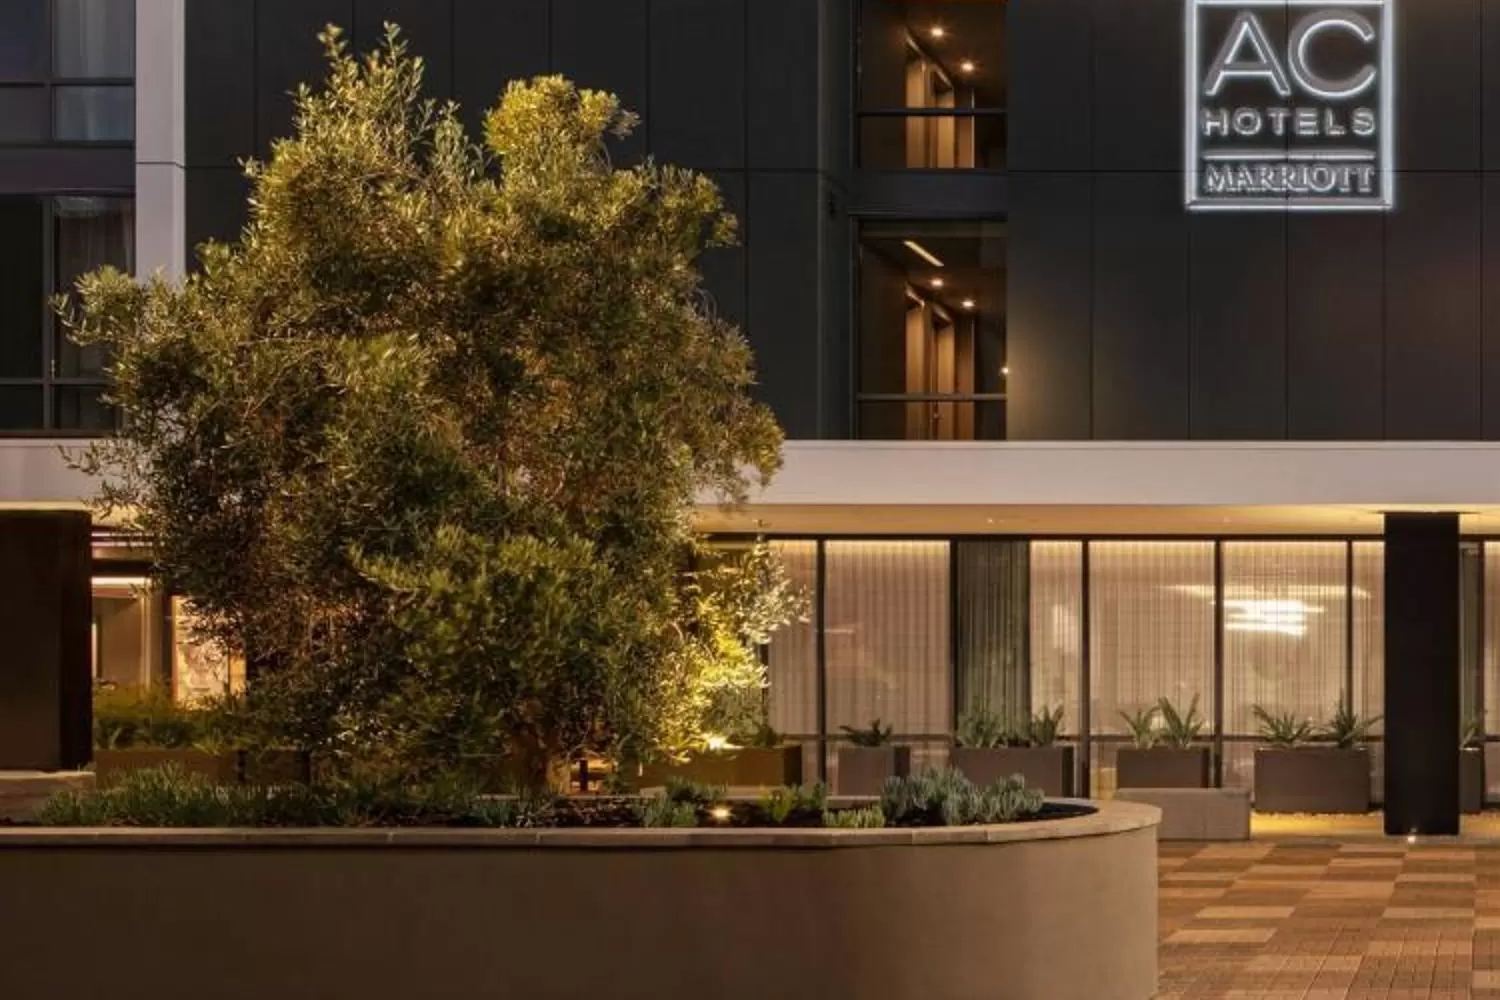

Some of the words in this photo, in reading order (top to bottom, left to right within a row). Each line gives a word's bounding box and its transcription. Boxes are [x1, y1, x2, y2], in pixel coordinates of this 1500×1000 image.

[1203, 9, 1376, 98] AC
[1202, 107, 1376, 136] HOTELS
[1203, 164, 1375, 193] MARRIOTT
